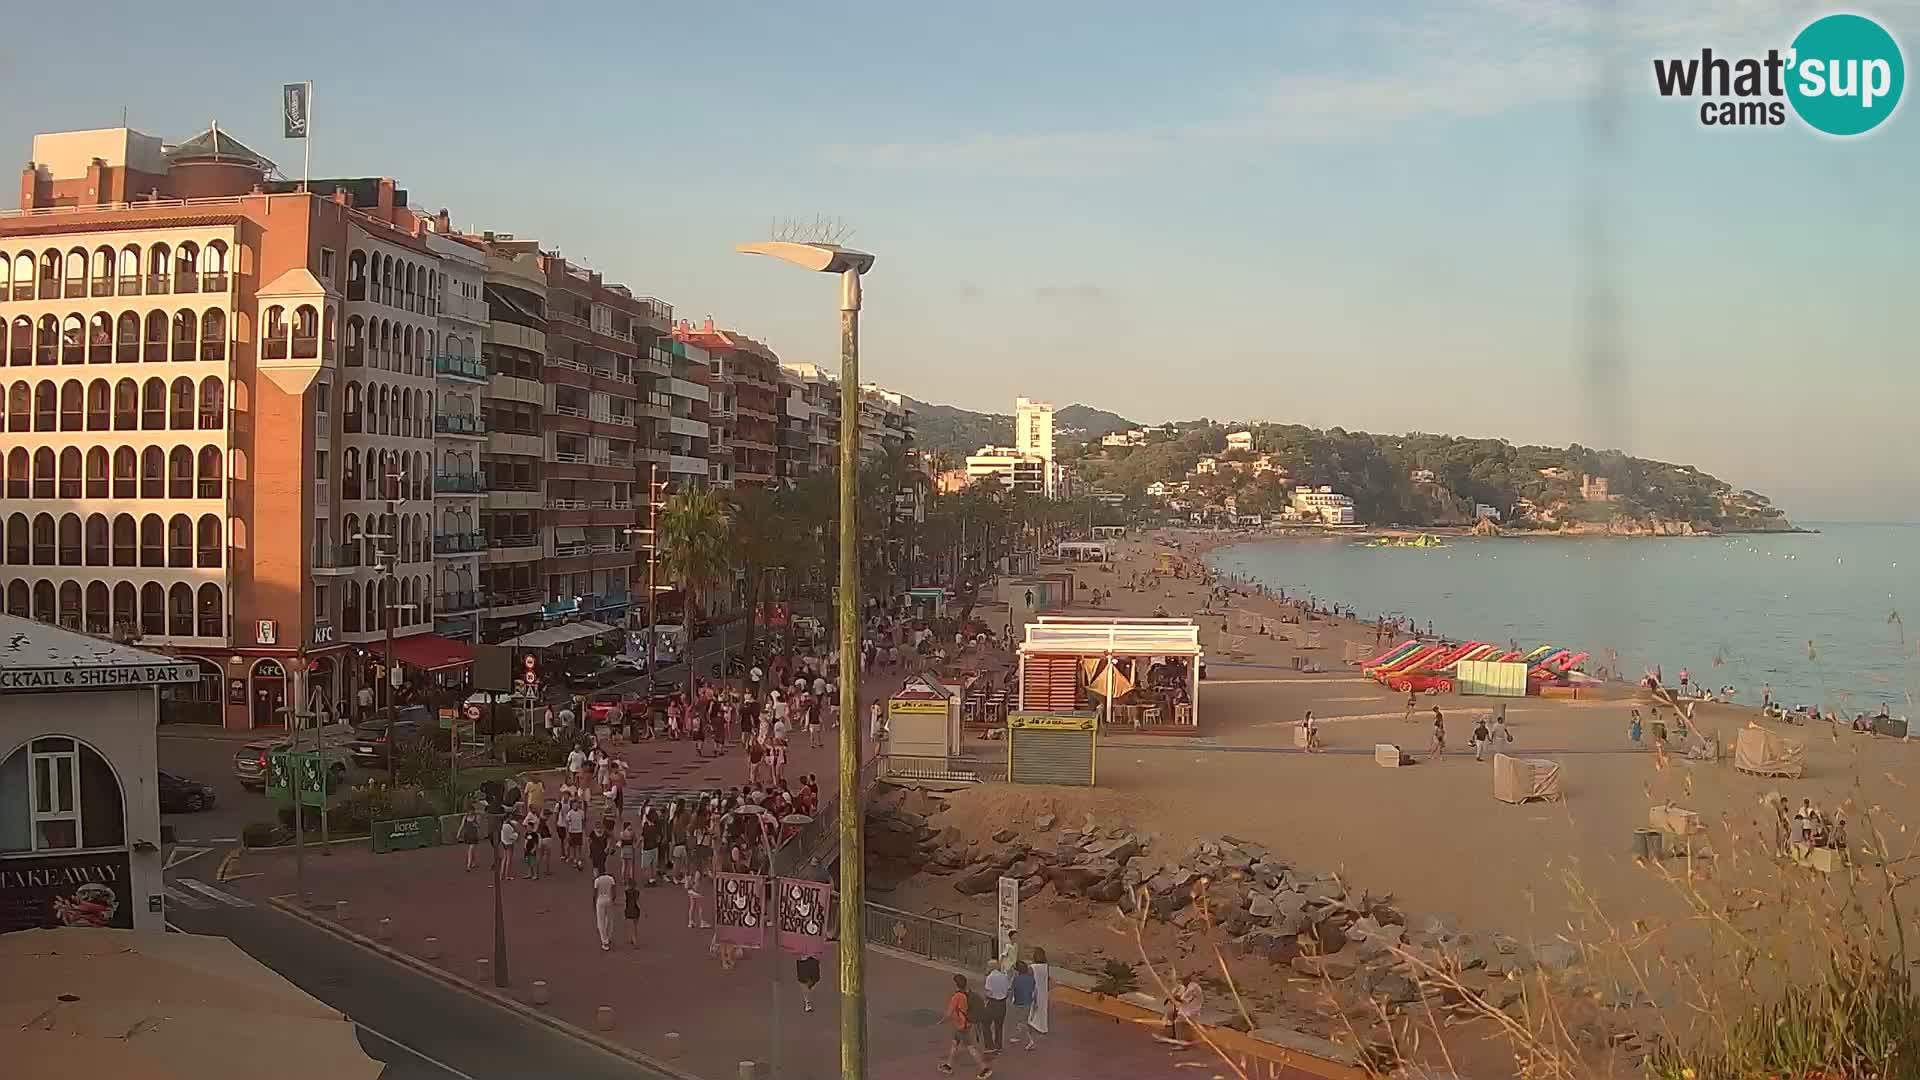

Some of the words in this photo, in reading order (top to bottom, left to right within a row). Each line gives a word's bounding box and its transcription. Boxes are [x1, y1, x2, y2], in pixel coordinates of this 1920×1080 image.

[314, 626, 333, 643] KFC
[64, 670, 75, 684] &
[80, 669, 140, 685] SHISHA
[147, 667, 179, 682] BAR
[258, 665, 282, 676] KFC
[0, 864, 120, 889] TAKEAWAY
